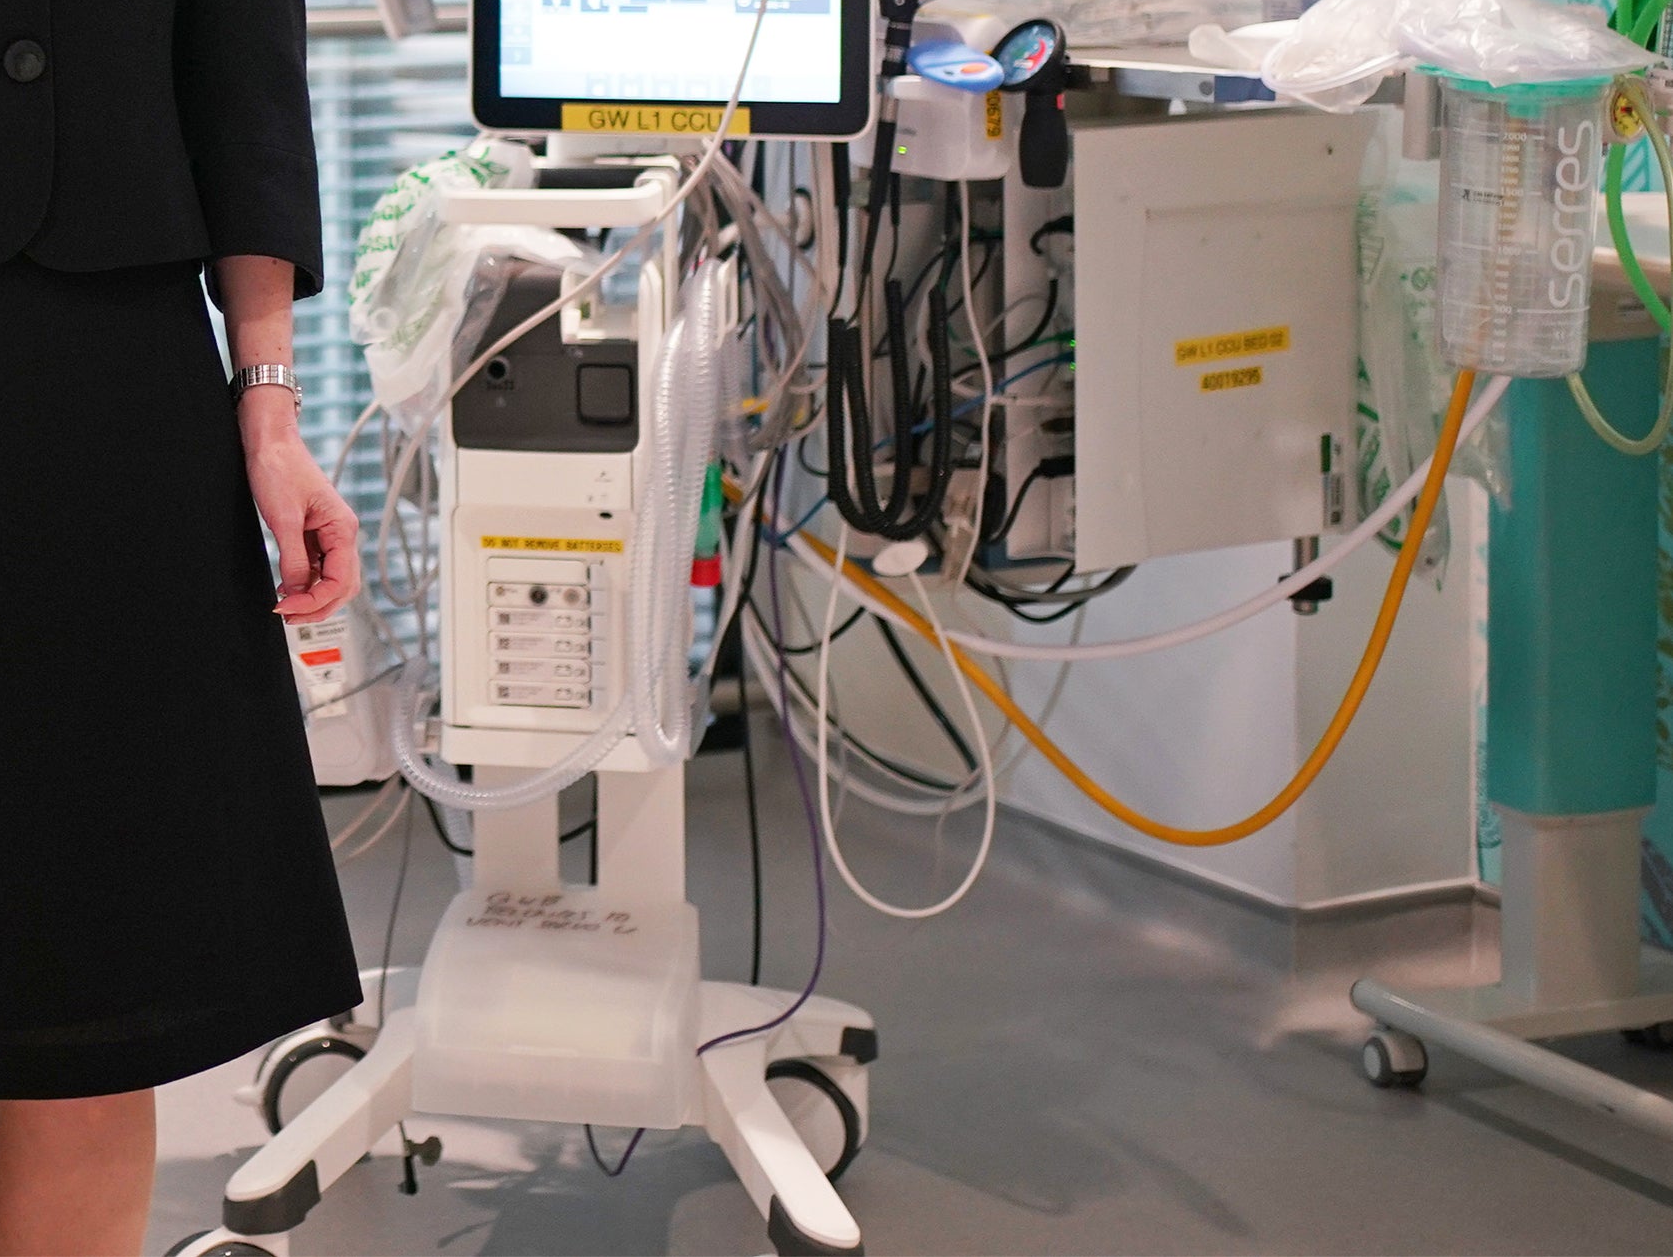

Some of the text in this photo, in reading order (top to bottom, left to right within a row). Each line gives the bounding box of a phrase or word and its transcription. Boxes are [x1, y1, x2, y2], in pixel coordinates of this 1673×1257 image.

[588, 110, 628, 130] GW
[671, 112, 723, 132] CCU
[1548, 120, 1595, 309] serres
